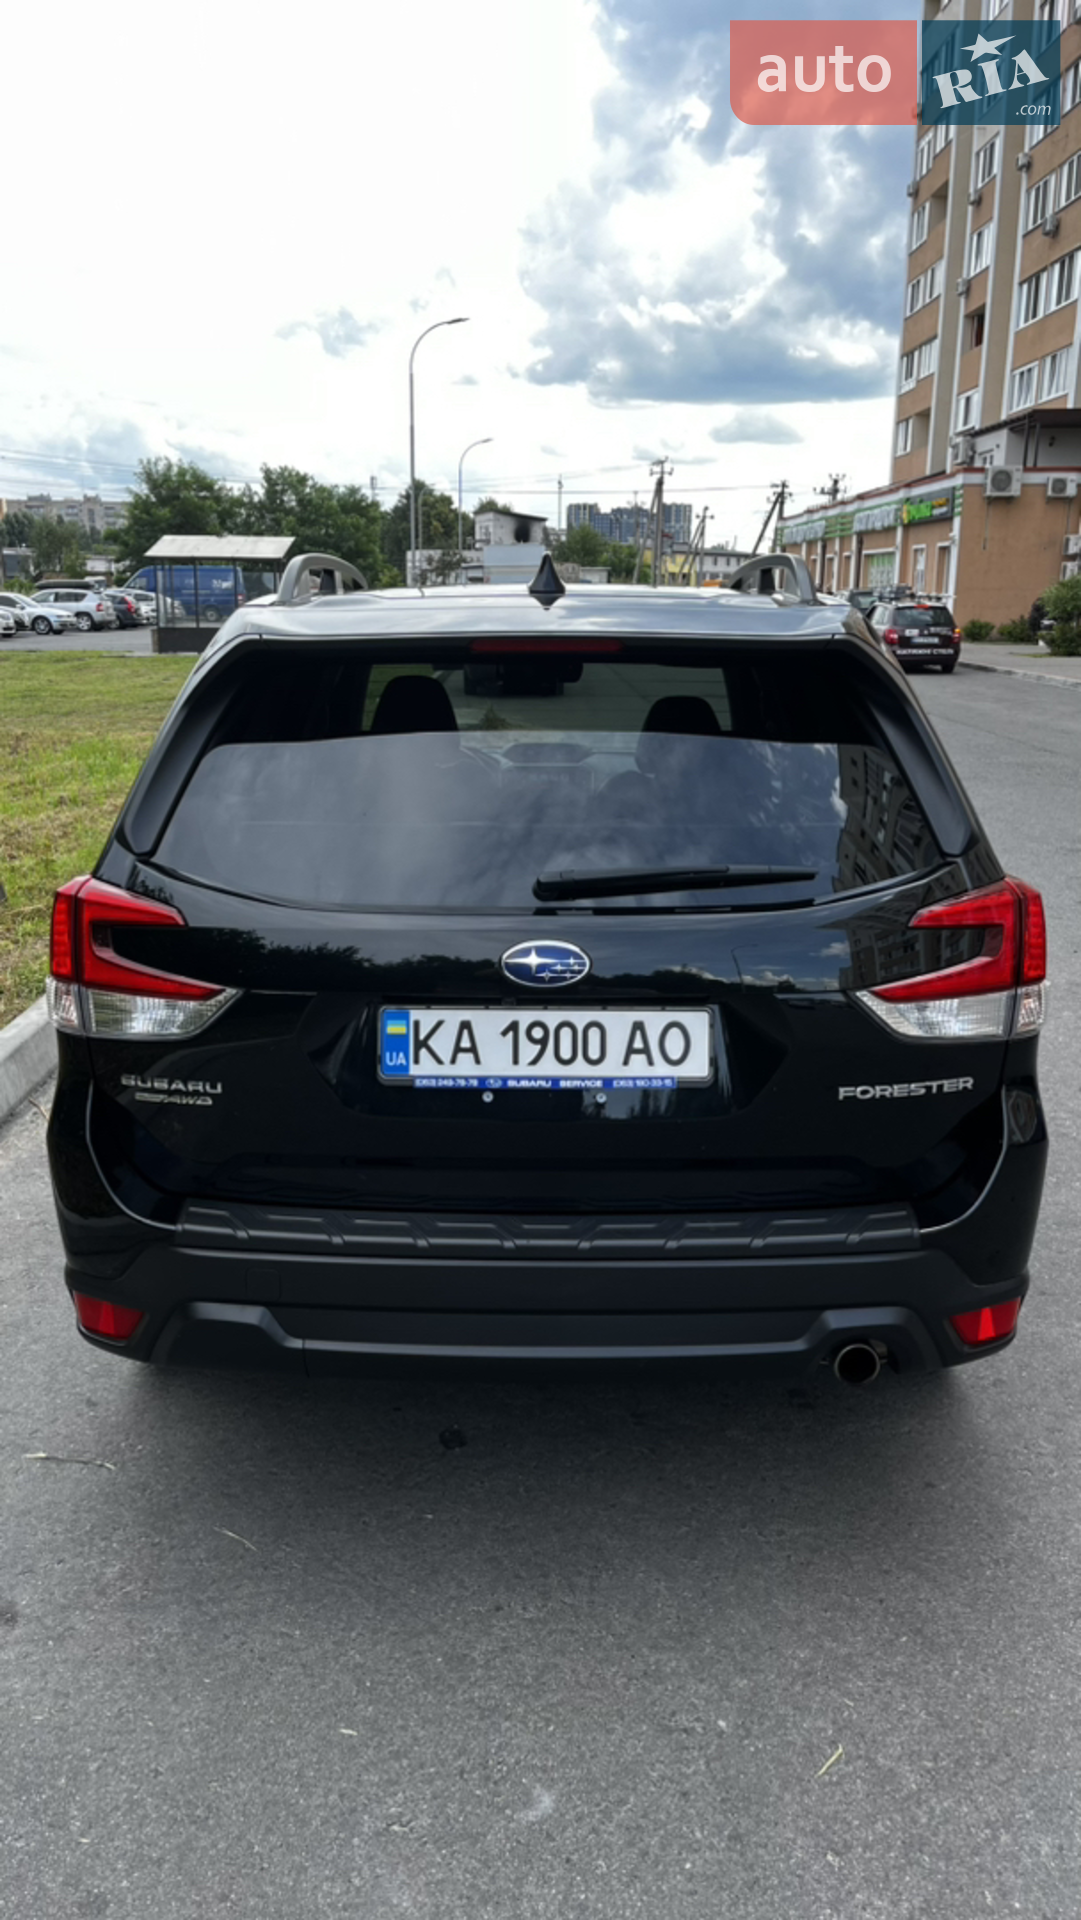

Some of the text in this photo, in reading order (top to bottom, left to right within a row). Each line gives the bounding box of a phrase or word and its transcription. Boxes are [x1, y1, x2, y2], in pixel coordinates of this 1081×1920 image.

[412, 1019, 692, 1068] KA 1900 AO
[386, 1052, 407, 1066] UA
[120, 1073, 223, 1094] SUBARU
[507, 1078, 552, 1088] SUBARU
[559, 1079, 603, 1088] SERVICE
[838, 1076, 974, 1101] FORESTER
